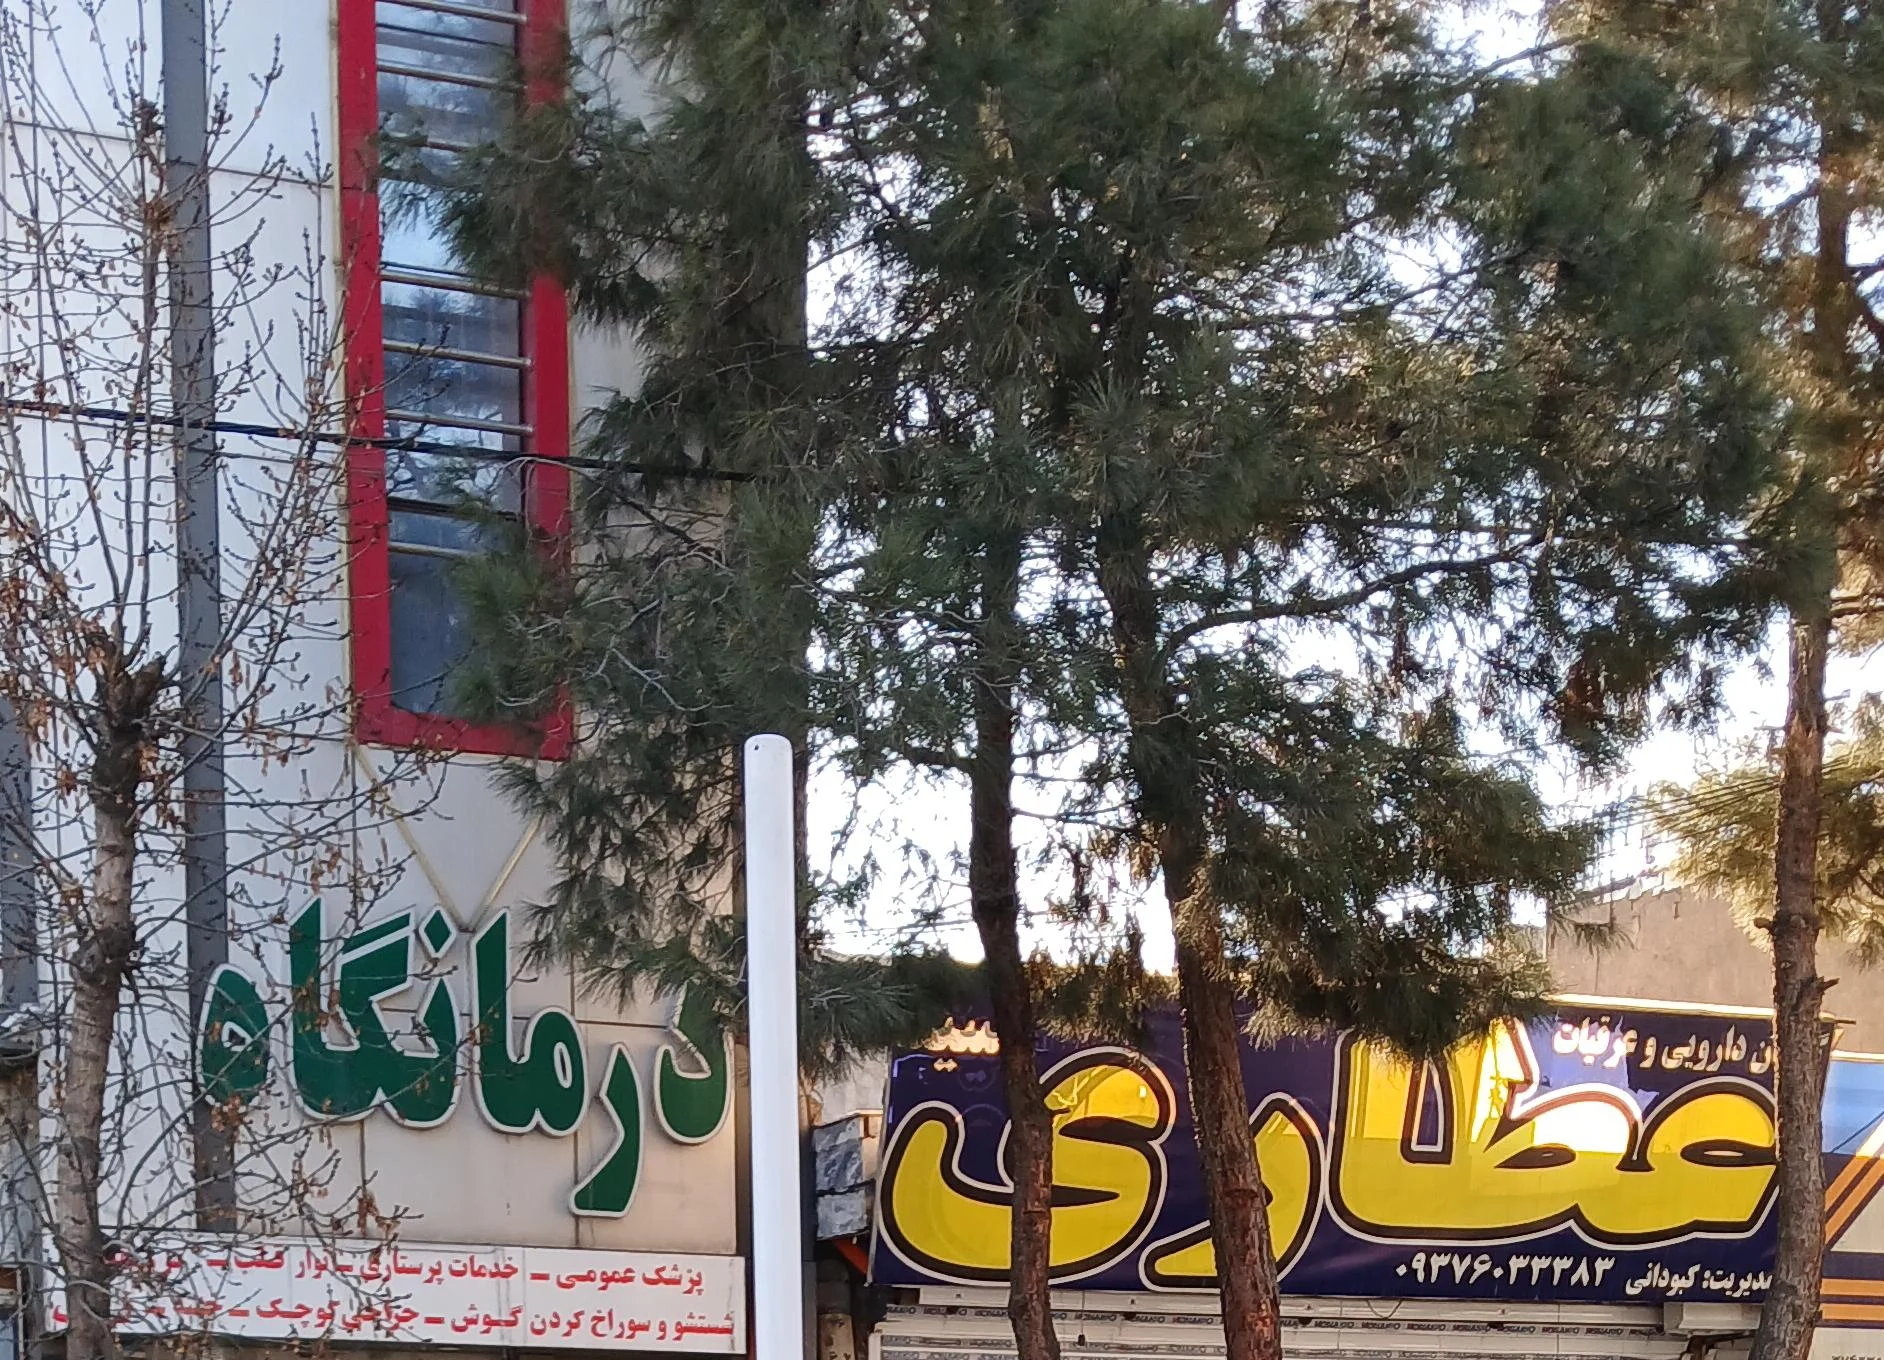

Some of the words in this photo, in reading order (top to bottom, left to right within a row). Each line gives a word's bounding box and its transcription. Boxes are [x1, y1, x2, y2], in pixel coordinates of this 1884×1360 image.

[199, 896, 734, 1218] درمانگاه
[1639, 1036, 1656, 1068] و
[1661, 1024, 1747, 1072] دارویی
[878, 1018, 1779, 1292] عطاری
[360, 1246, 444, 1284] پرستاری
[449, 1255, 519, 1279] خدمات
[556, 1267, 635, 1291] عمومی
[642, 1264, 704, 1295] پزشک
[1396, 1252, 1616, 1286] ۰۹۳۷۶۰۳۳۳۸۳
[1625, 1262, 1701, 1296] کبودانی
[256, 1298, 340, 1330] کوچک
[451, 1304, 525, 1334] گوش
[530, 1310, 585, 1337] کردن
[590, 1308, 651, 1340] سوراخ
[656, 1320, 667, 1340] و
[672, 1311, 735, 1341] شستشو
